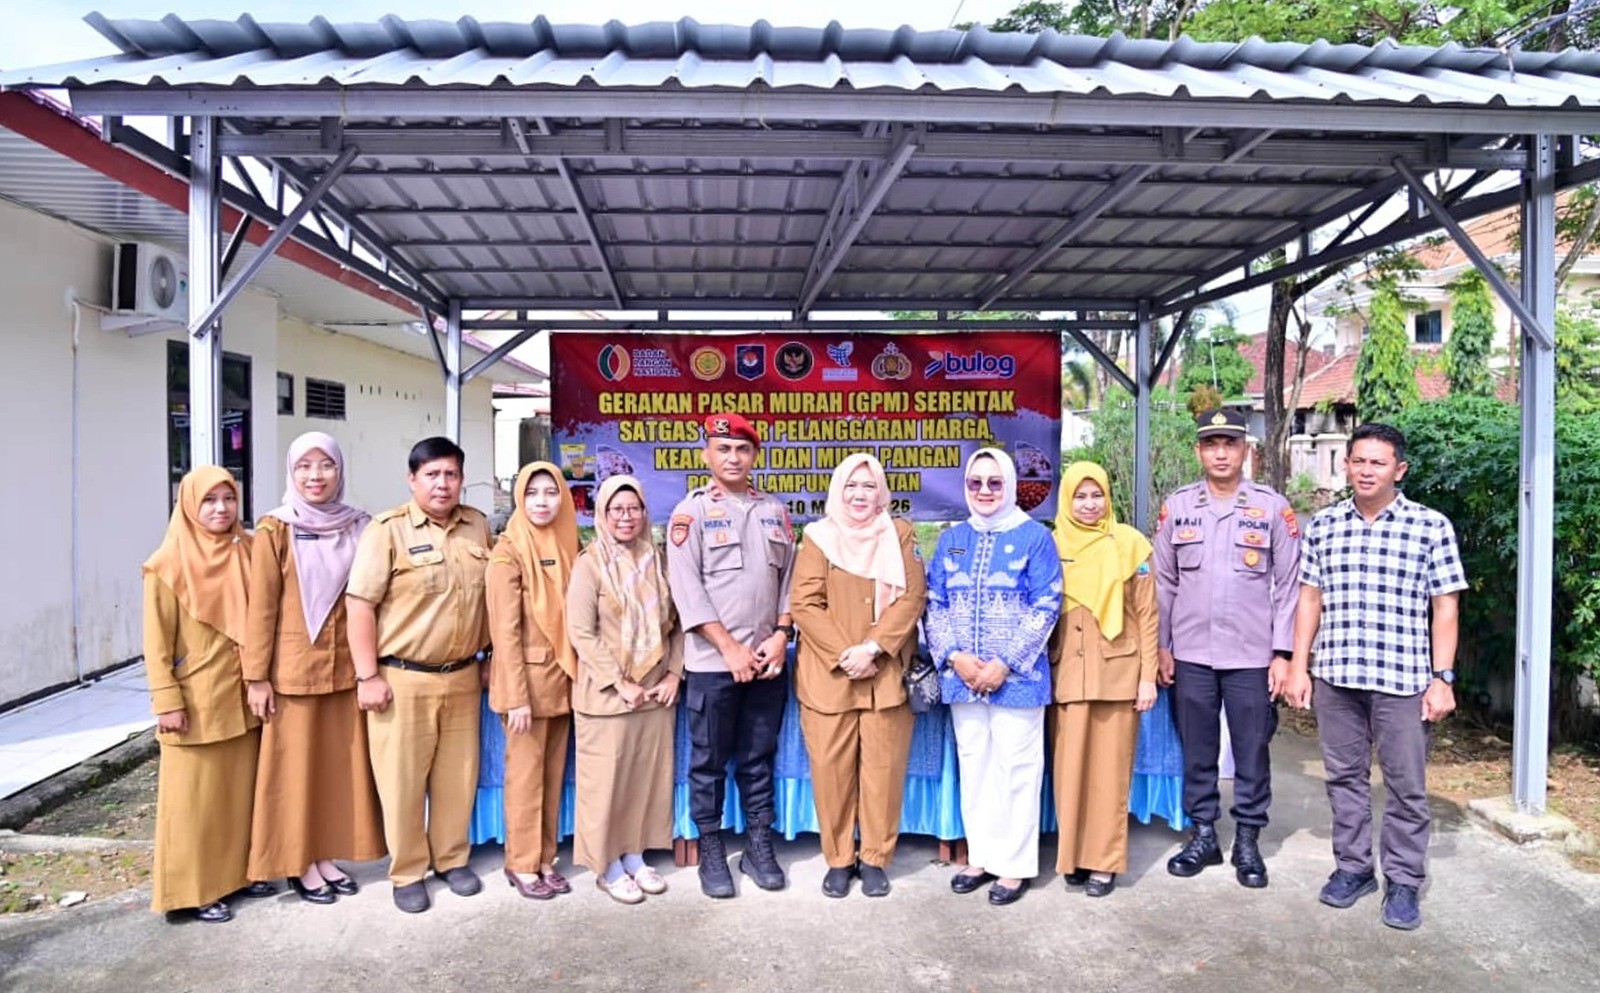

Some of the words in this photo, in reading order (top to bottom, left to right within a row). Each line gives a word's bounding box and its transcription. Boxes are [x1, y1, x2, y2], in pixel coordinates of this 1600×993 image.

[946, 350, 1015, 378] bulog
[599, 392, 692, 414] GERAKAN
[698, 392, 764, 414] PASAR
[769, 391, 843, 413] MURAH
[849, 391, 909, 413] (GPM)
[914, 390, 1015, 412] SERENTAK
[619, 420, 700, 442] SATGAS
[774, 418, 917, 441] PELANGGARAN
[921, 418, 995, 441] HARGA,
[771, 446, 812, 469] DAN
[879, 445, 960, 468] PANGAN
[1238, 520, 1269, 531] POLRI
